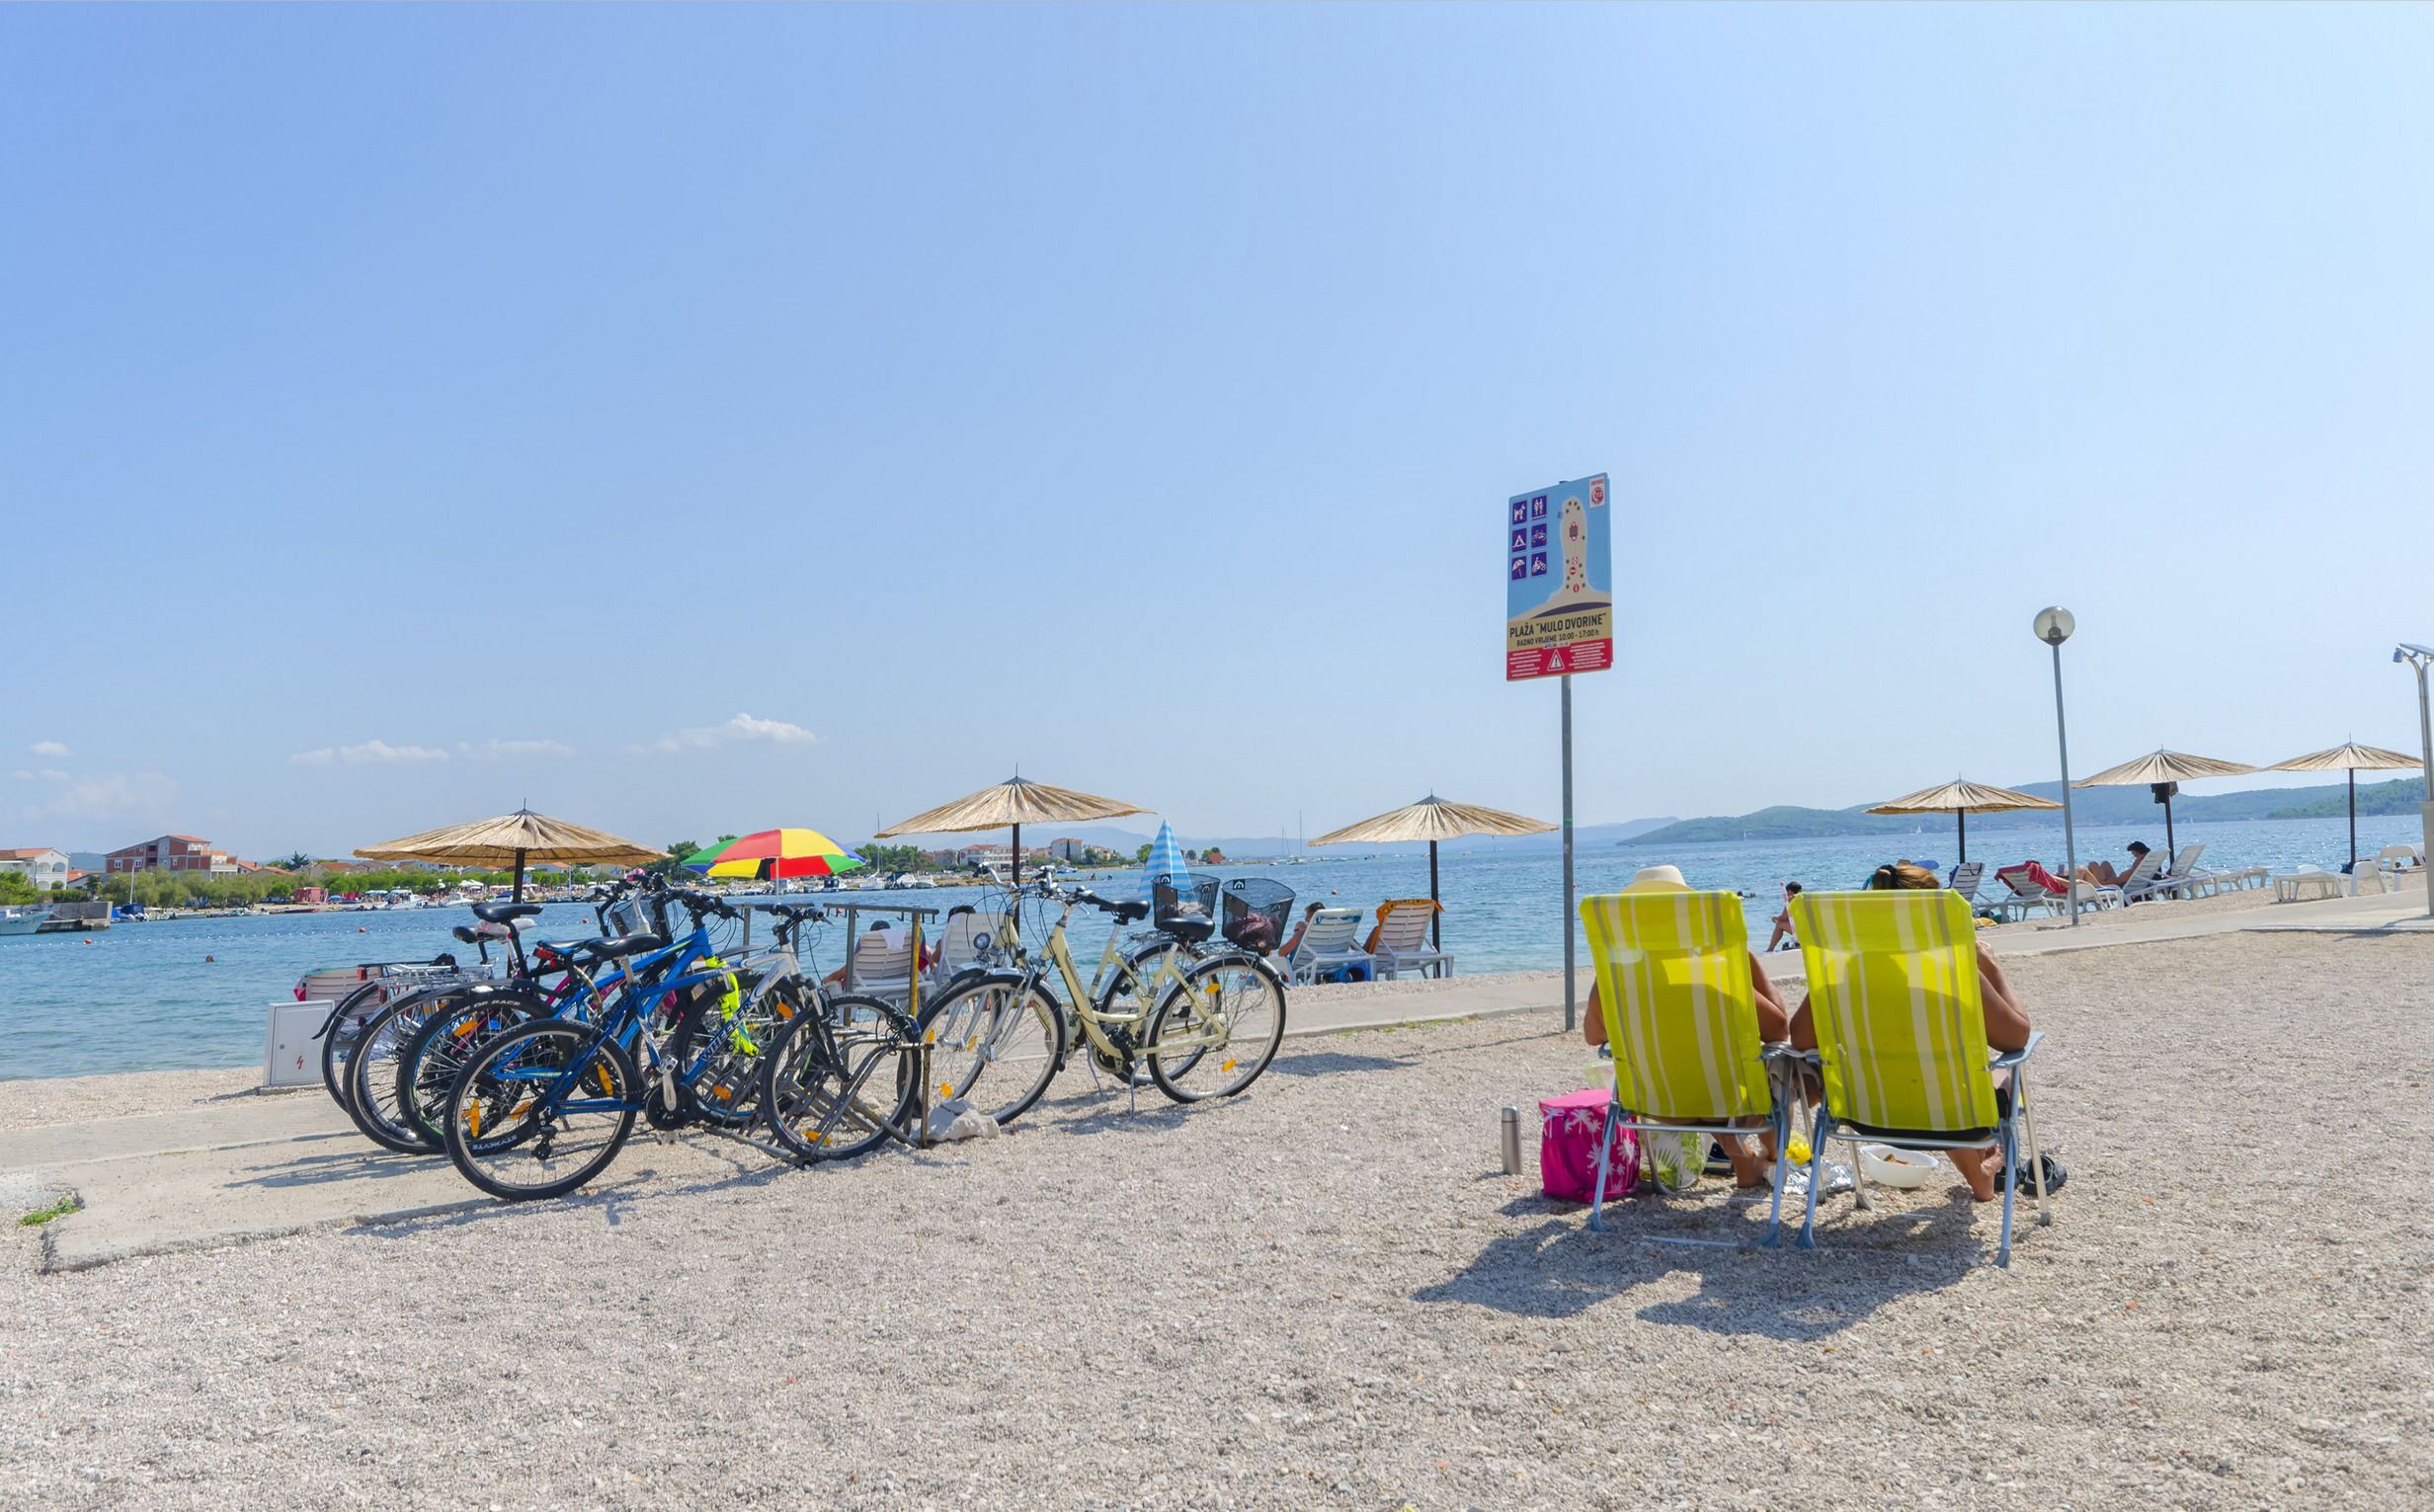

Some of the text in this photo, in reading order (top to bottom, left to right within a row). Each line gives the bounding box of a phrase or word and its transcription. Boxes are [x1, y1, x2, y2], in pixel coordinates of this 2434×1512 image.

[1509, 622, 1534, 638] PLAŽA
[1516, 638, 1534, 647] RADNO
[1535, 635, 1557, 644] VRIJEME
[1559, 632, 1575, 641] 10:00
[1579, 629, 1594, 638] 17:00
[450, 1005, 470, 1018] ACE
[700, 1000, 753, 1061] WHEELER
